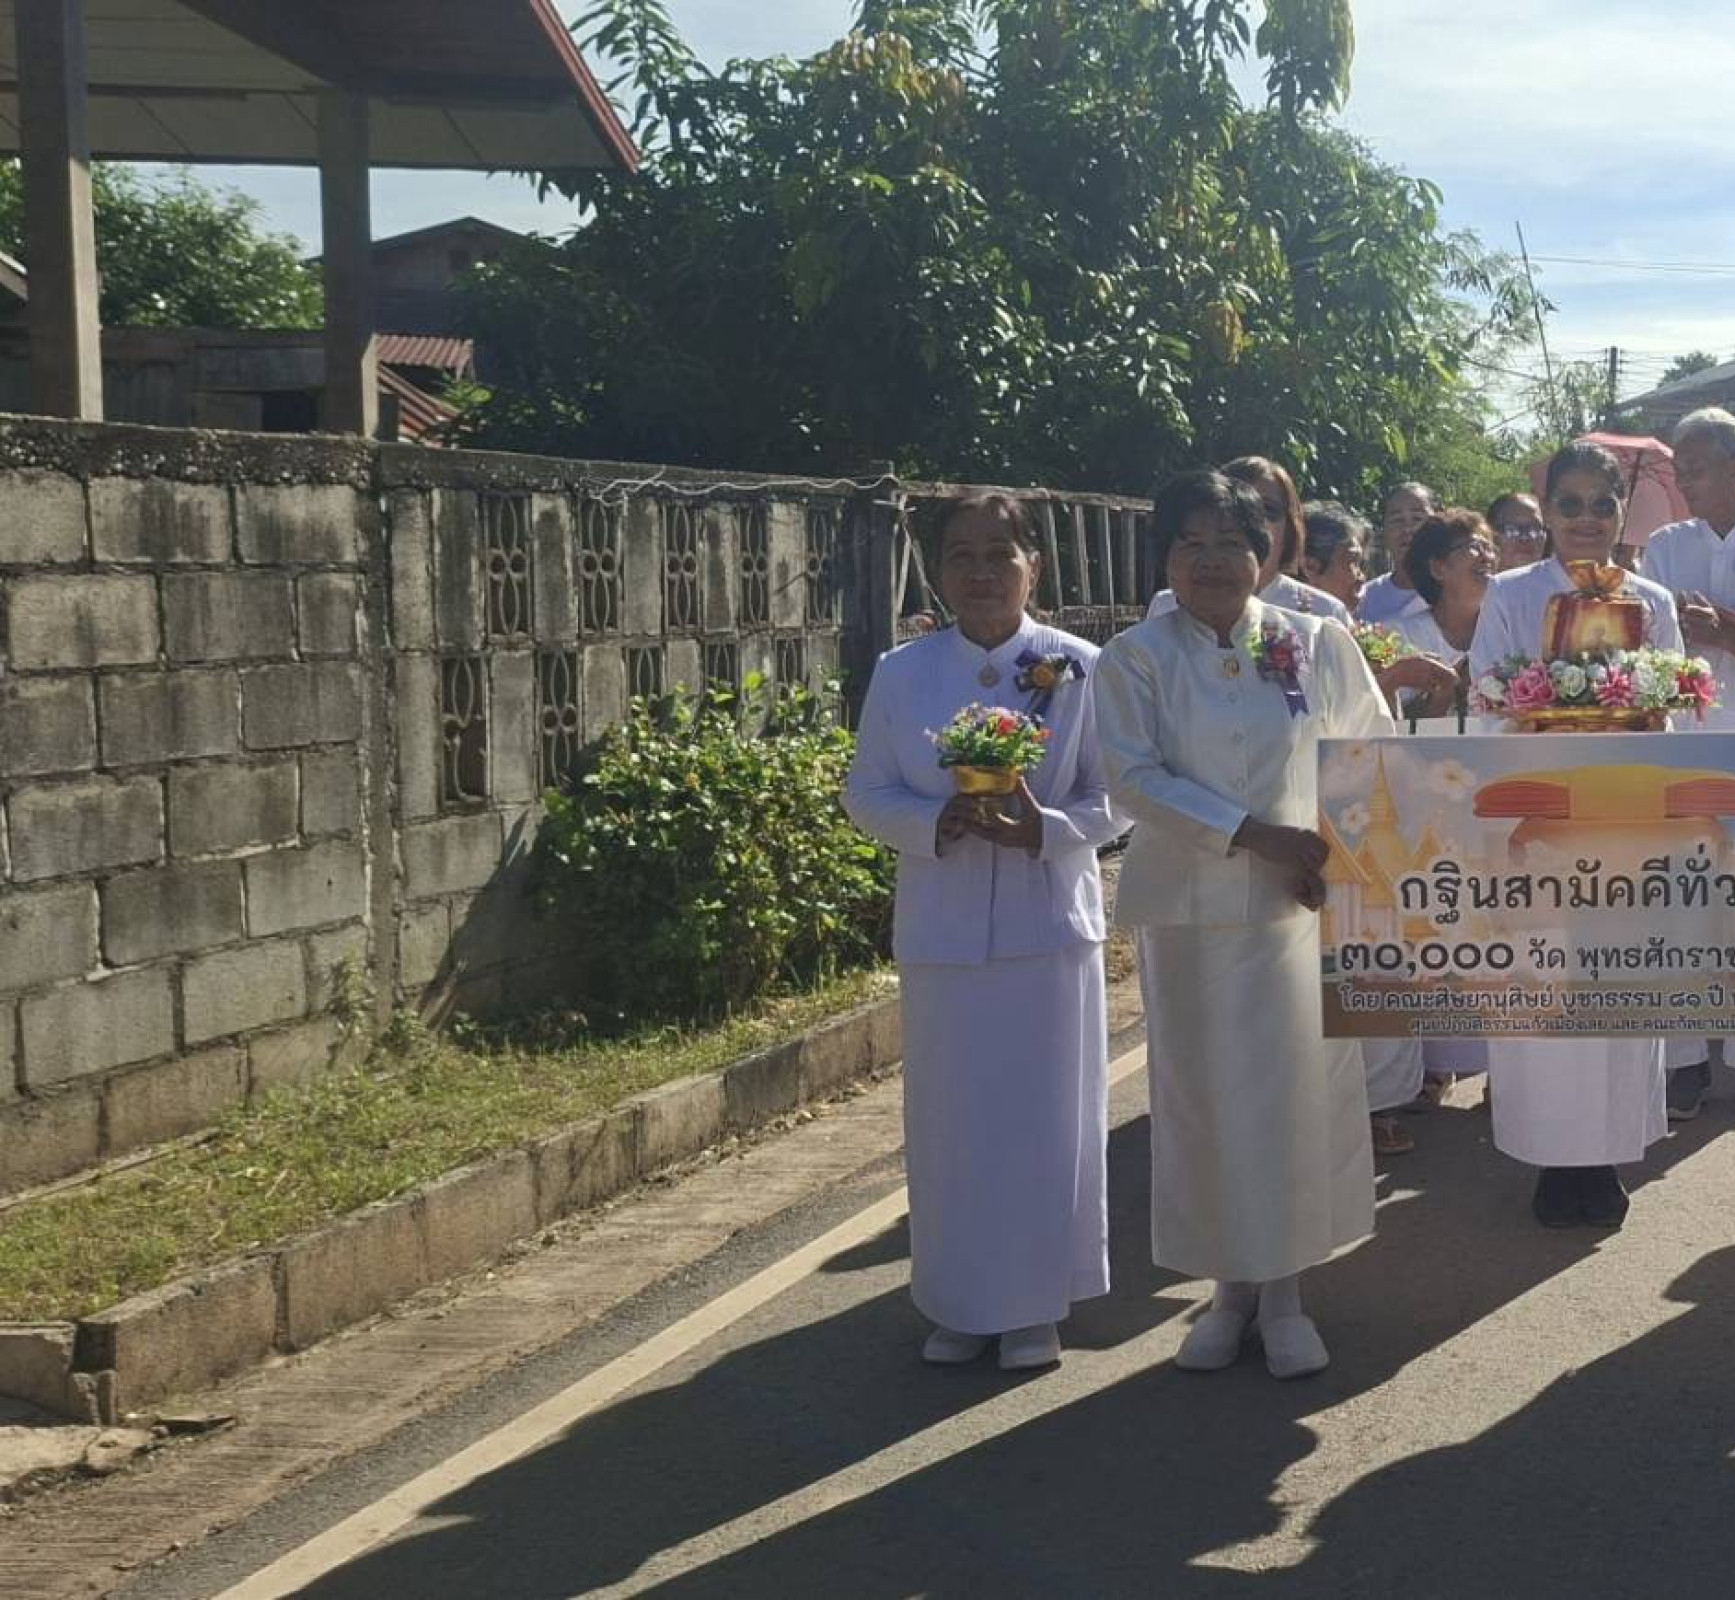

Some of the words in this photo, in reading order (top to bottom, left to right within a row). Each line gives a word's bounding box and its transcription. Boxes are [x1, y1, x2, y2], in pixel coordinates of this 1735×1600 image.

[1341, 942, 1514, 976] ๓๐,๐๐๐
[1529, 937, 1566, 969] วัด
[1340, 985, 1379, 1008] โดย
[1561, 994, 1662, 1016] บูชาธรรม
[1709, 984, 1725, 1007] ปี
